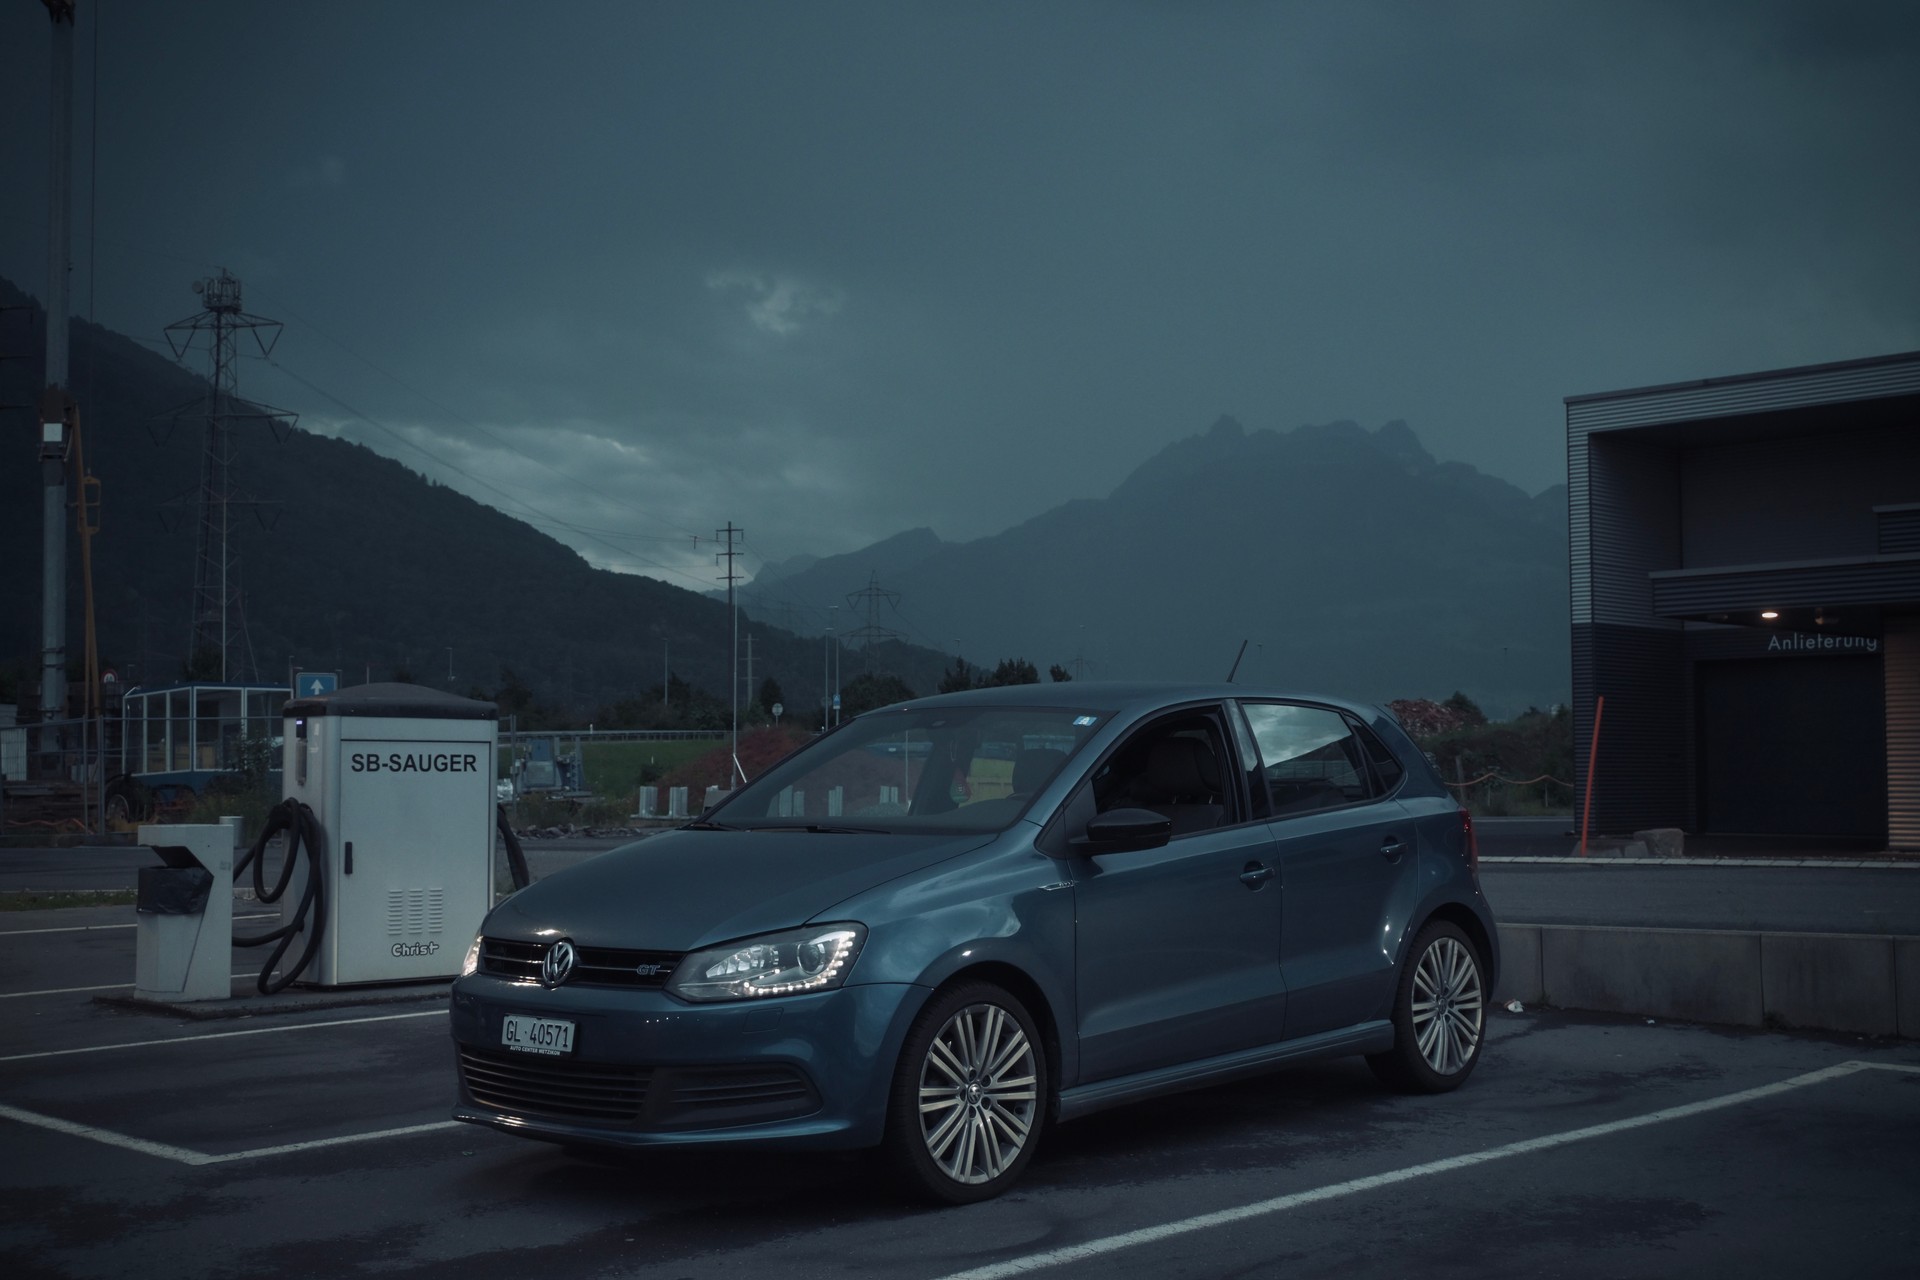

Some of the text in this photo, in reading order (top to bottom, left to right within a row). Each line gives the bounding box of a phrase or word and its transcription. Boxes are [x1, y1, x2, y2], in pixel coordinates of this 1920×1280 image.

[351, 753, 477, 772] SB-SAUGER
[391, 941, 440, 957] Christ
[637, 964, 660, 975] GT
[530, 1022, 569, 1048] 40571
